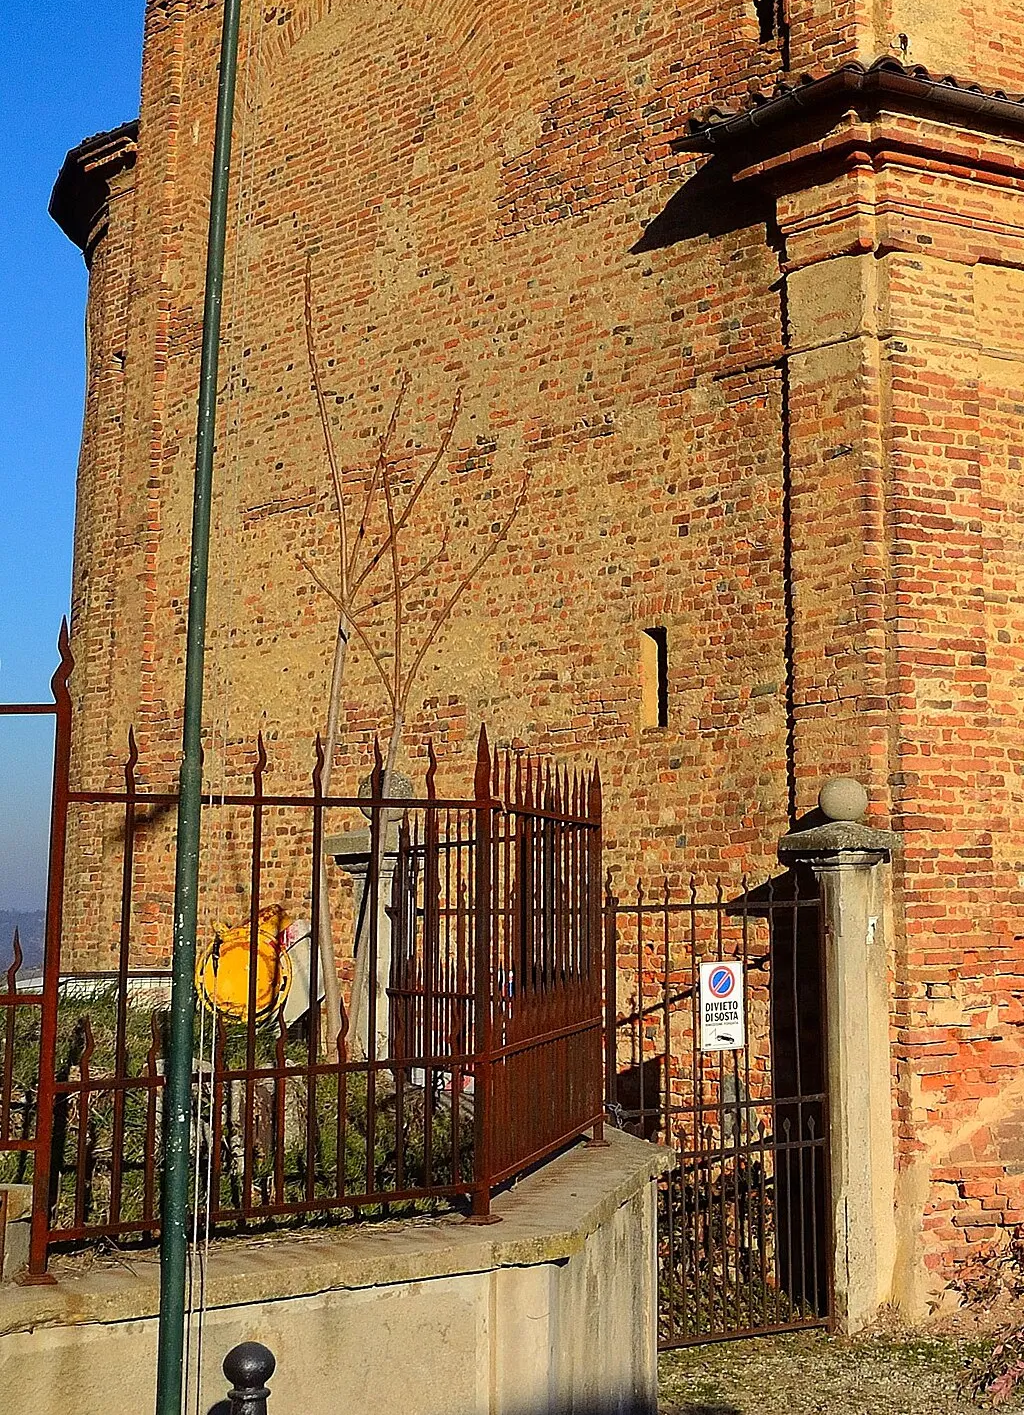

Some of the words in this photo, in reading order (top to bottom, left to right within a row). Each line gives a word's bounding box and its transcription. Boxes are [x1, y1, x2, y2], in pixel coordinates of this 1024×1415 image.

[705, 1000, 738, 1012] DIVIETO
[705, 1012, 713, 1022] DI
[714, 1011, 739, 1022] SOSTA
